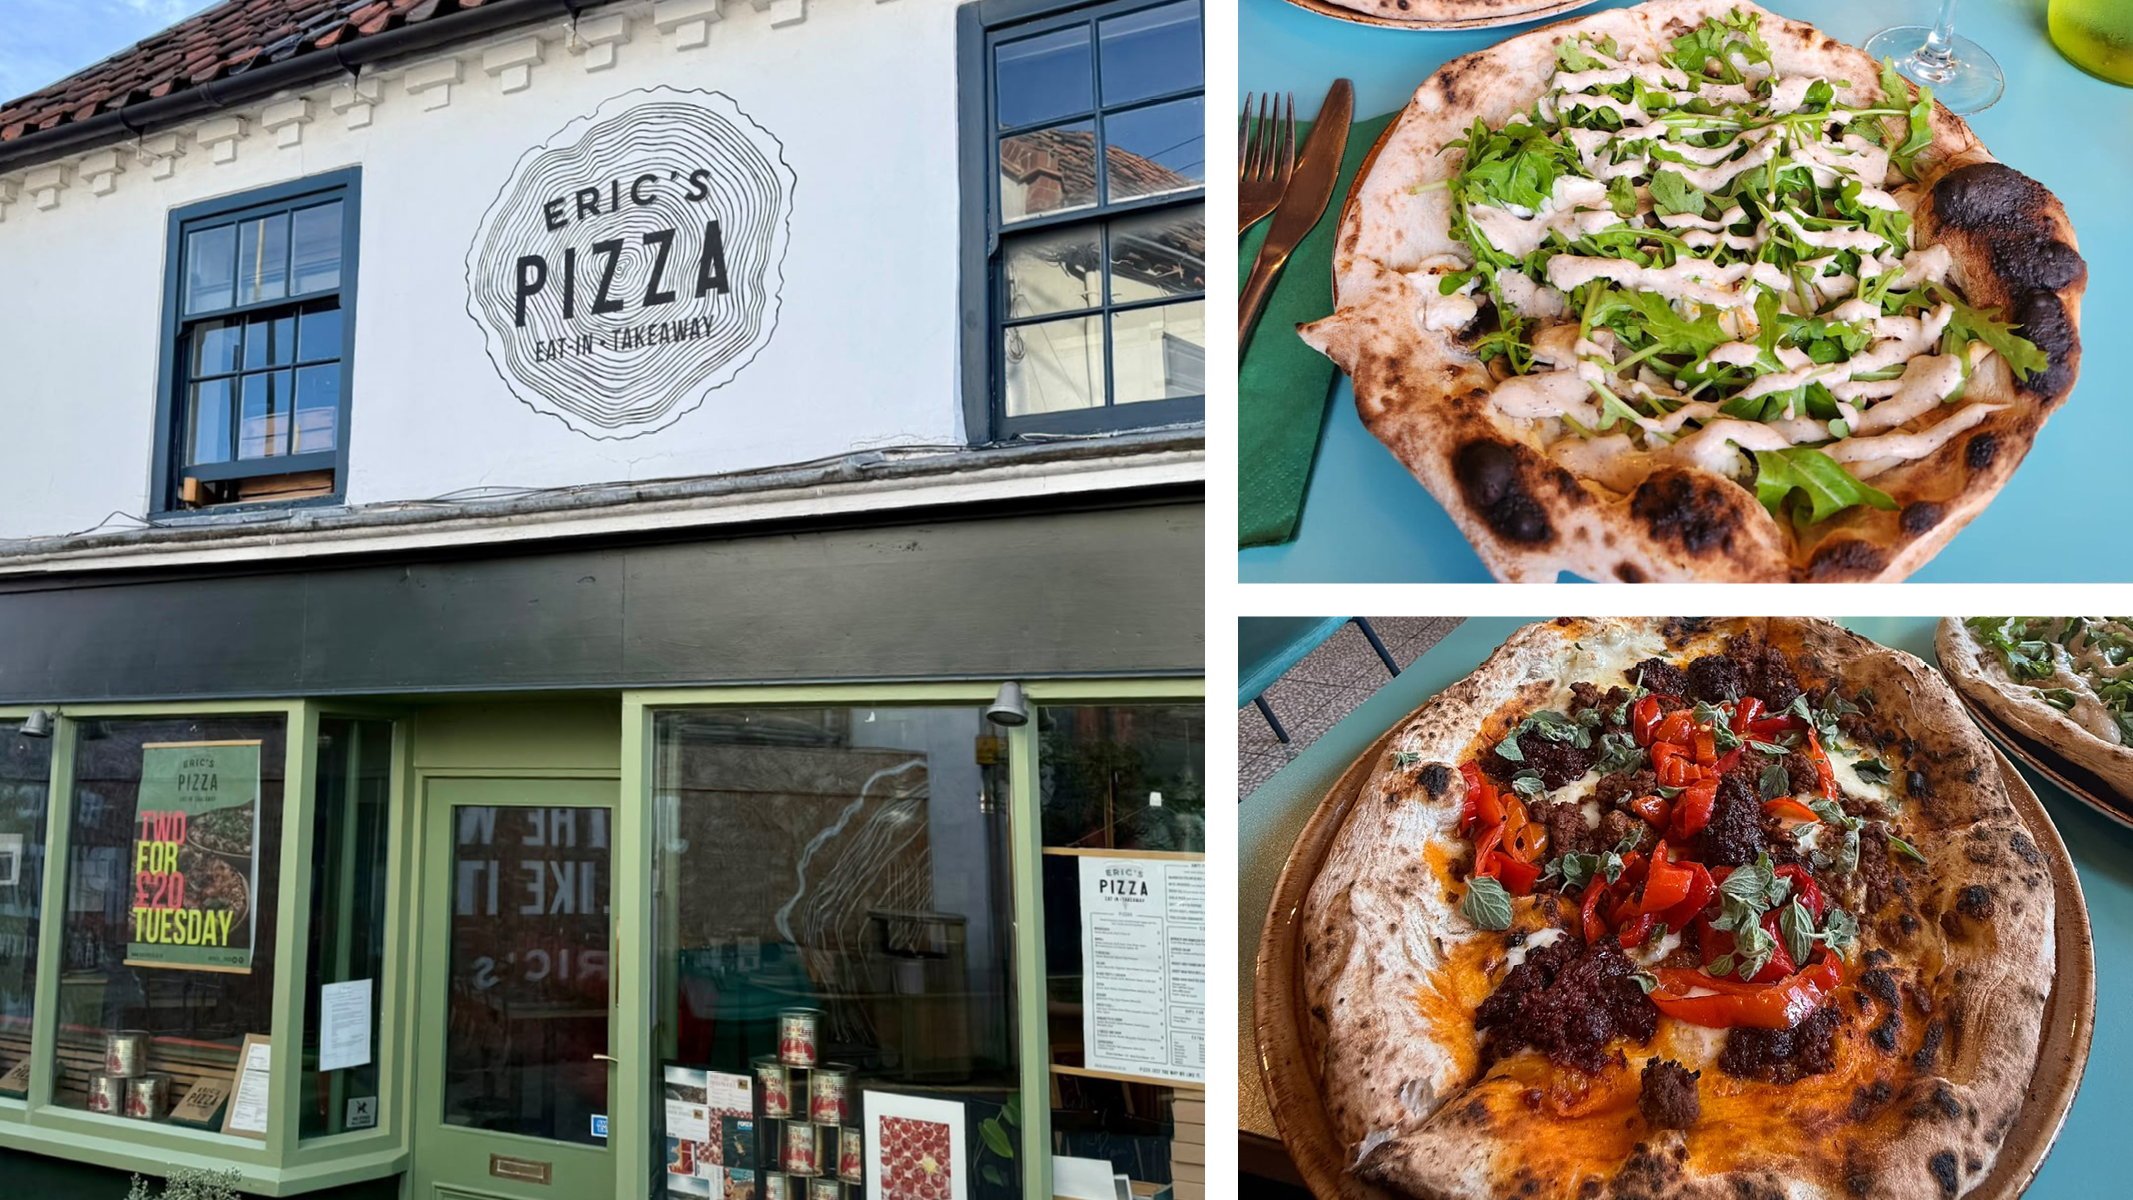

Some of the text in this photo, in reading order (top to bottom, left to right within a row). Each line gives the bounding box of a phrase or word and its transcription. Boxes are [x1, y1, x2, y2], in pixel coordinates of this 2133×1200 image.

[543, 168, 711, 232] ERIC'S
[515, 219, 729, 327] PIZZA
[535, 315, 714, 363] EAT-IN TAKEAWAY
[183, 758, 214, 769] ERIC'S
[178, 773, 218, 791] PIZZA
[140, 810, 187, 845] TWO
[136, 840, 179, 876] FOR
[1105, 868, 1143, 878] ERIC'S
[135, 870, 184, 909] £20
[1099, 879, 1148, 896] PIZZA
[132, 907, 234, 946] TUESDAY
[186, 1092, 218, 1106] PIZZA
